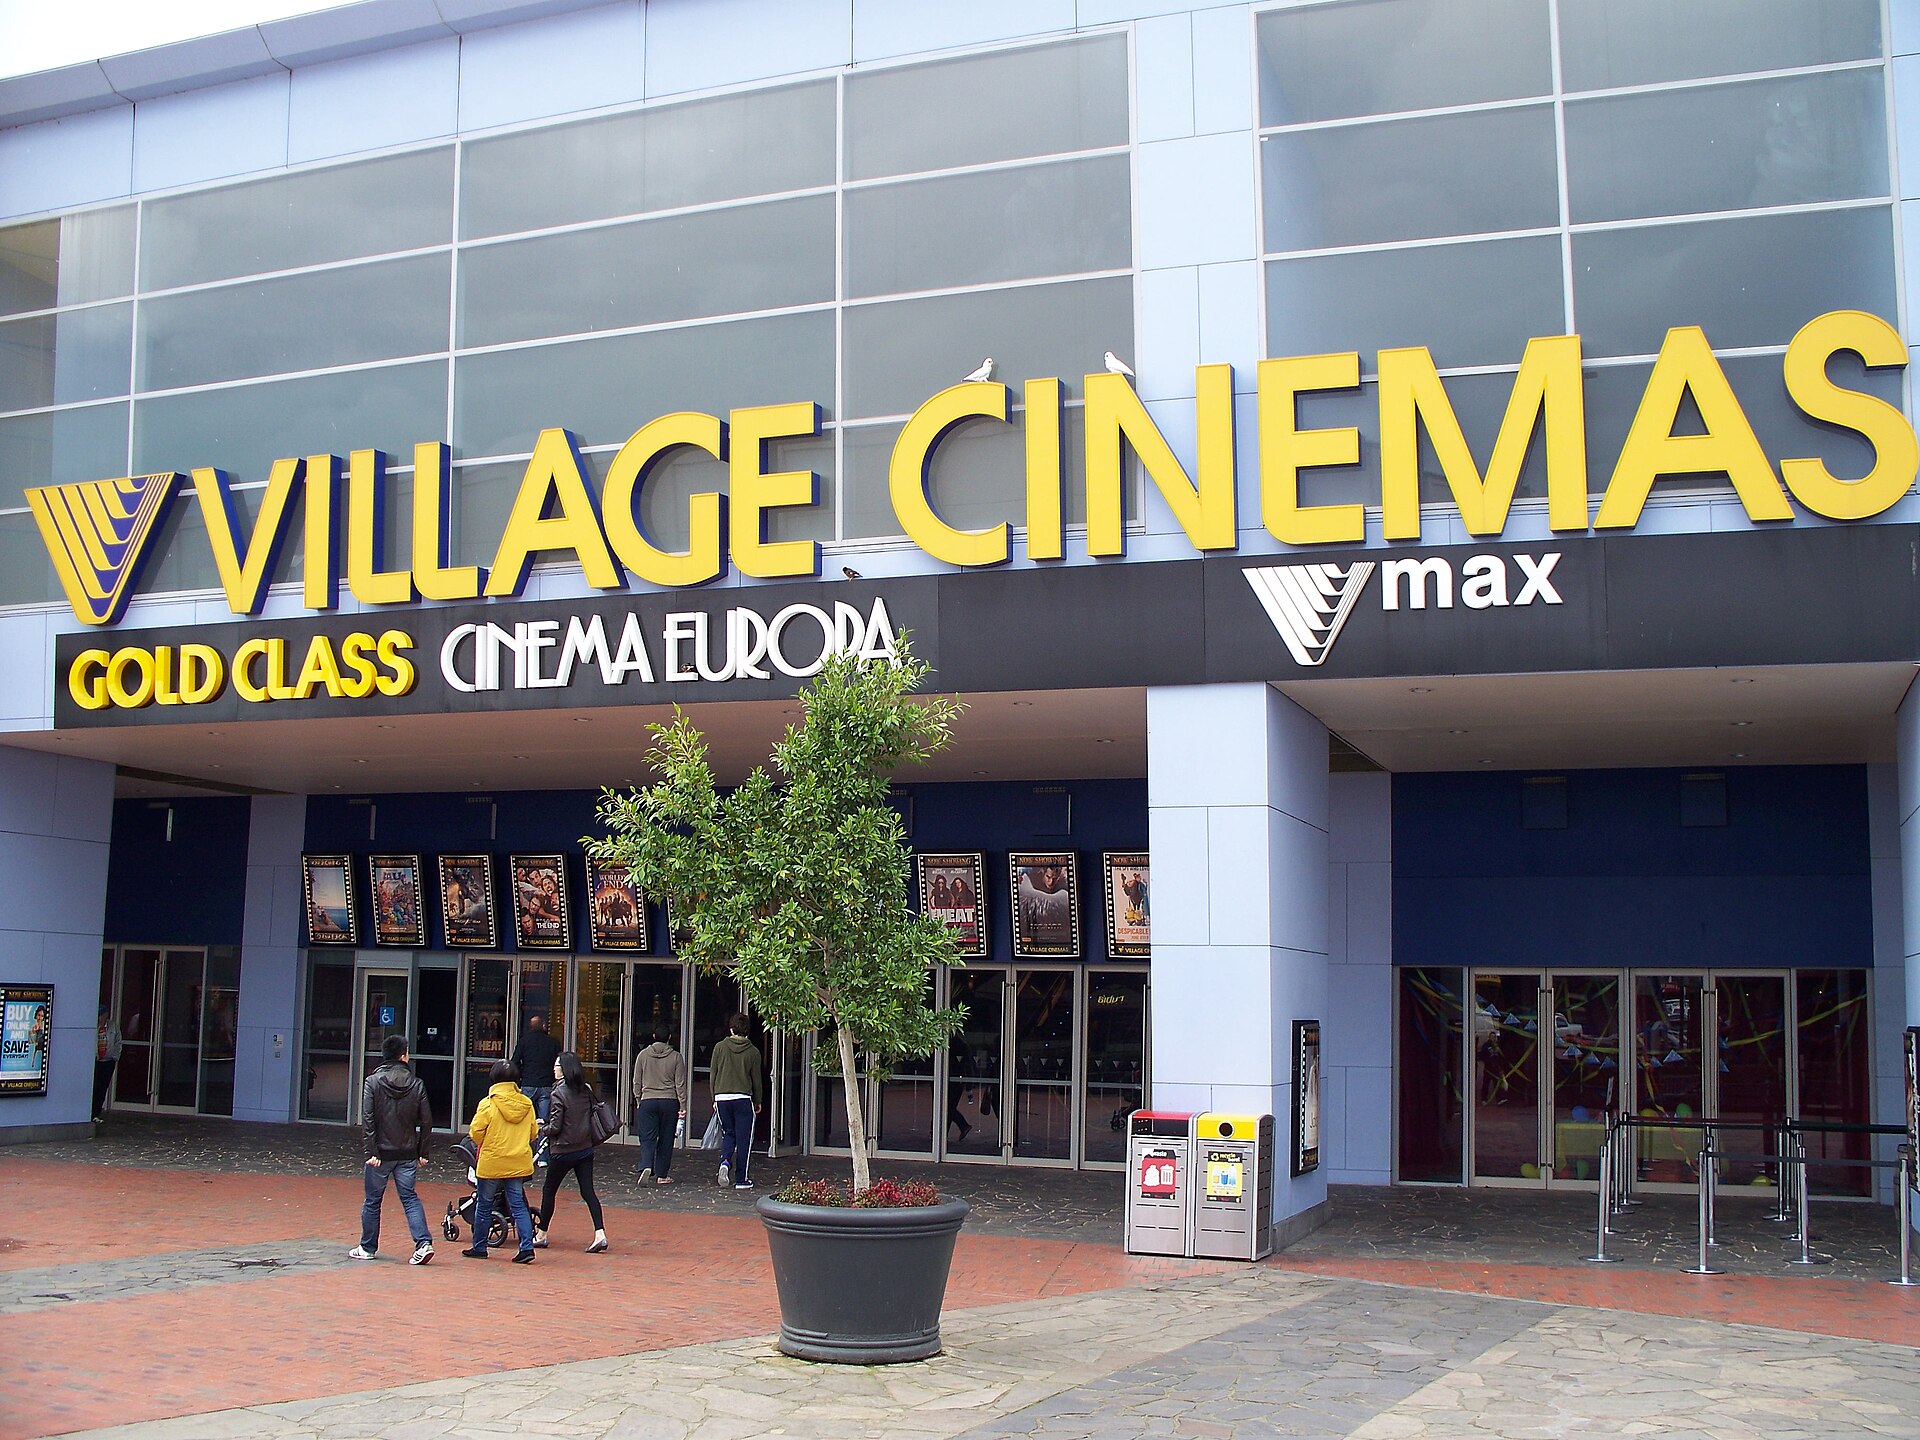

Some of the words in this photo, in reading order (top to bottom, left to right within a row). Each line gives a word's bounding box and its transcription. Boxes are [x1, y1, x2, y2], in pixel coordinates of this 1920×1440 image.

[190, 401, 823, 614] VILLAGE
[888, 310, 1919, 568] CINEMAS
[440, 611, 654, 692] CINEMA
[663, 596, 901, 682] EUROPA
[68, 643, 223, 710] GOLD
[231, 630, 414, 703] CLASS
[604, 880, 624, 889] END
[939, 908, 975, 923] HEAT
[1118, 927, 1149, 935] DESPICABLE
[7, 1004, 32, 1021] BUY
[6, 1021, 30, 1030] ONLINE
[11, 1030, 25, 1039] AND
[3, 1040, 29, 1054] SAVE
[480, 1040, 502, 1051] HEAT
